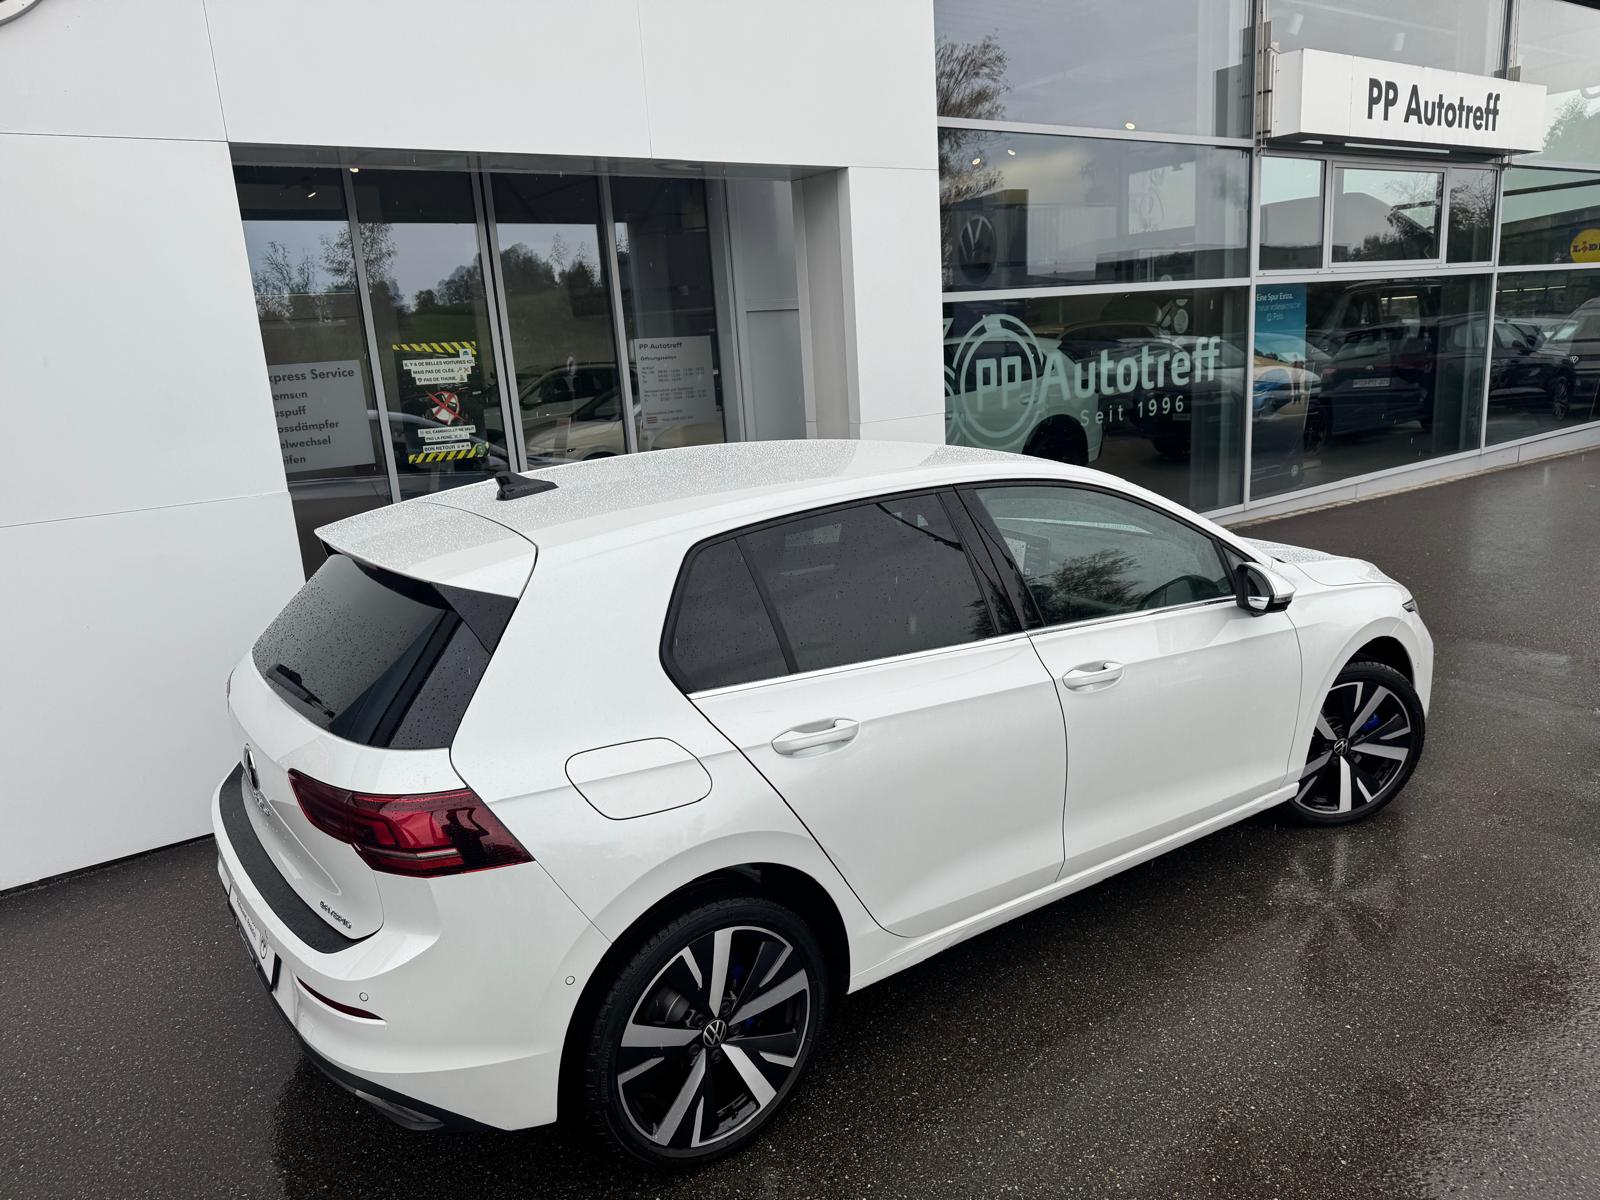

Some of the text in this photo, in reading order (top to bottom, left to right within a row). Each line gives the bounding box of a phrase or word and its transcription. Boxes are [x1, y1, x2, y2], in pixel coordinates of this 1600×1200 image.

[1367, 78, 1501, 132] PP Autotreff
[650, 341, 682, 349] Autotreff
[1038, 335, 1221, 402] Autotreff
[269, 368, 354, 384] xpress Service
[273, 391, 308, 401] emsen
[275, 405, 306, 418] uspuff
[1080, 395, 1184, 427] Seit 1996
[278, 420, 339, 433] ossdämpfer
[280, 435, 331, 449] elwechsel
[284, 455, 306, 465] ifen
